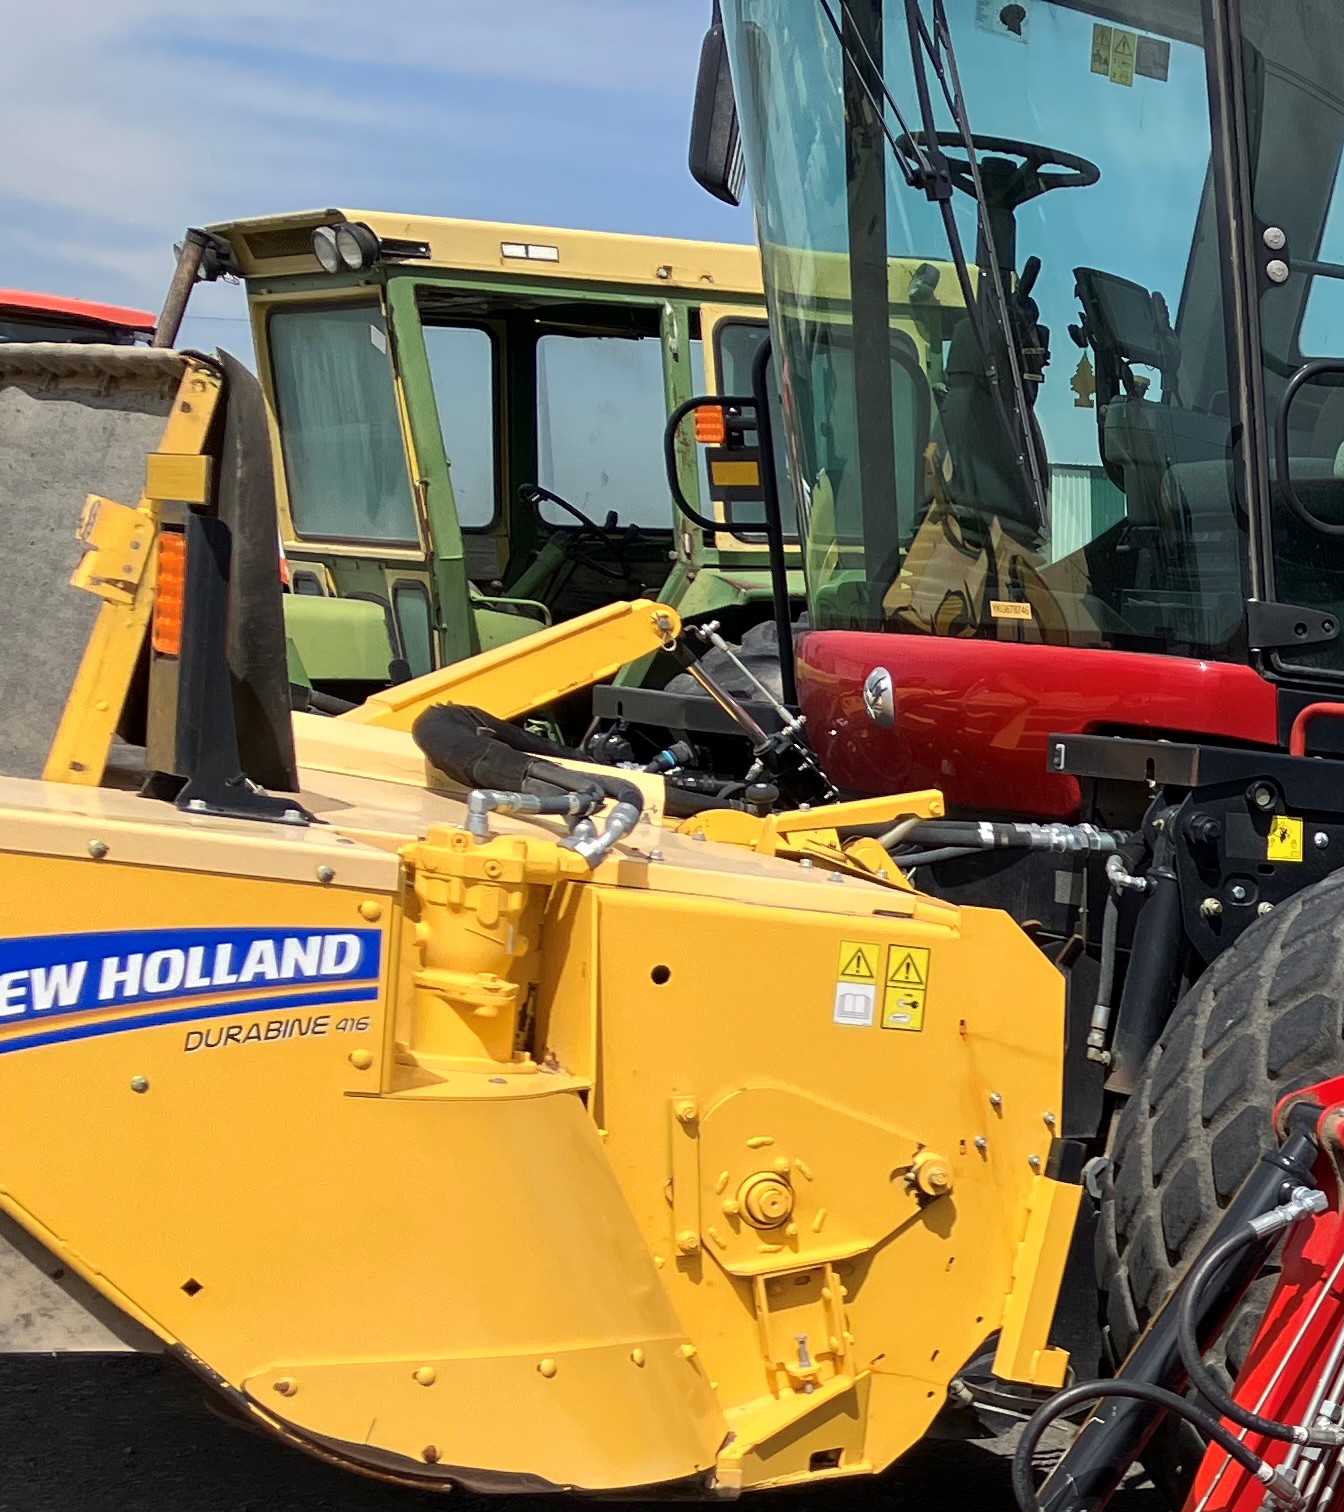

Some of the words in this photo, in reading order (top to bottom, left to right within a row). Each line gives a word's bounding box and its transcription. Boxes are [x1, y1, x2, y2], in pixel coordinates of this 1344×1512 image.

[98, 933, 362, 1001] HOLLAND
[184, 1015, 332, 1052] DURABINE
[335, 1015, 371, 1034] 416
